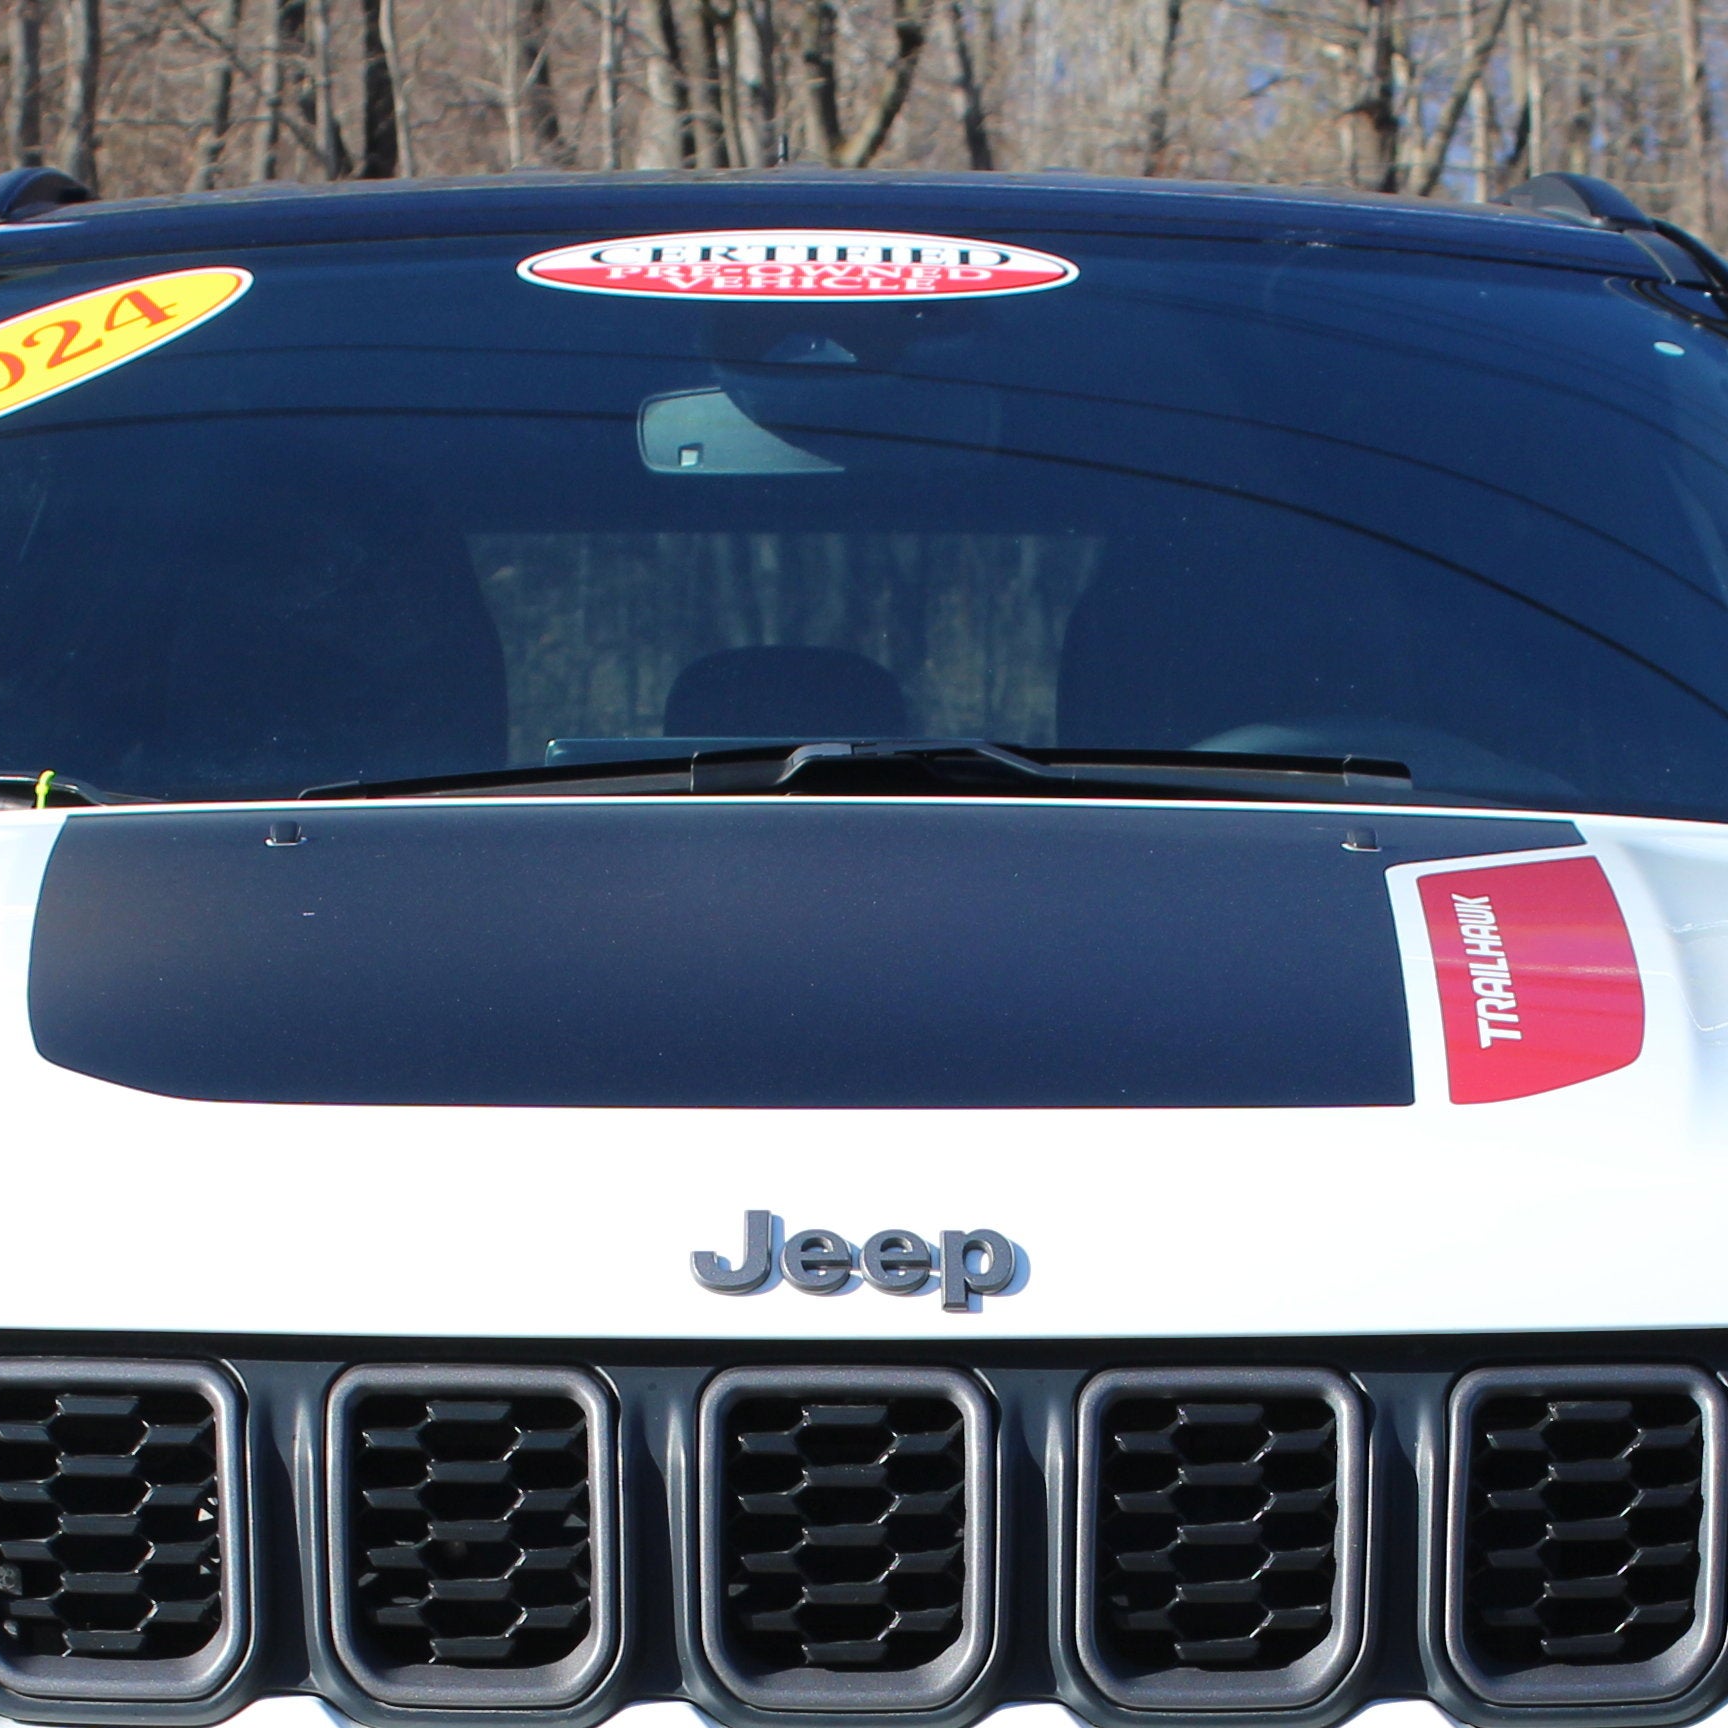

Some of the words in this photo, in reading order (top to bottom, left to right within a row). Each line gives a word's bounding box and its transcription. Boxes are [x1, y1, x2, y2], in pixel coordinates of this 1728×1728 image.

[591, 244, 1011, 267] CERTIFIED
[606, 264, 994, 281] PRE-OWNED
[665, 275, 937, 292] VEHICLE
[1451, 892, 1523, 1050] TRAILHAWK
[689, 1209, 1016, 1312] Jeep
